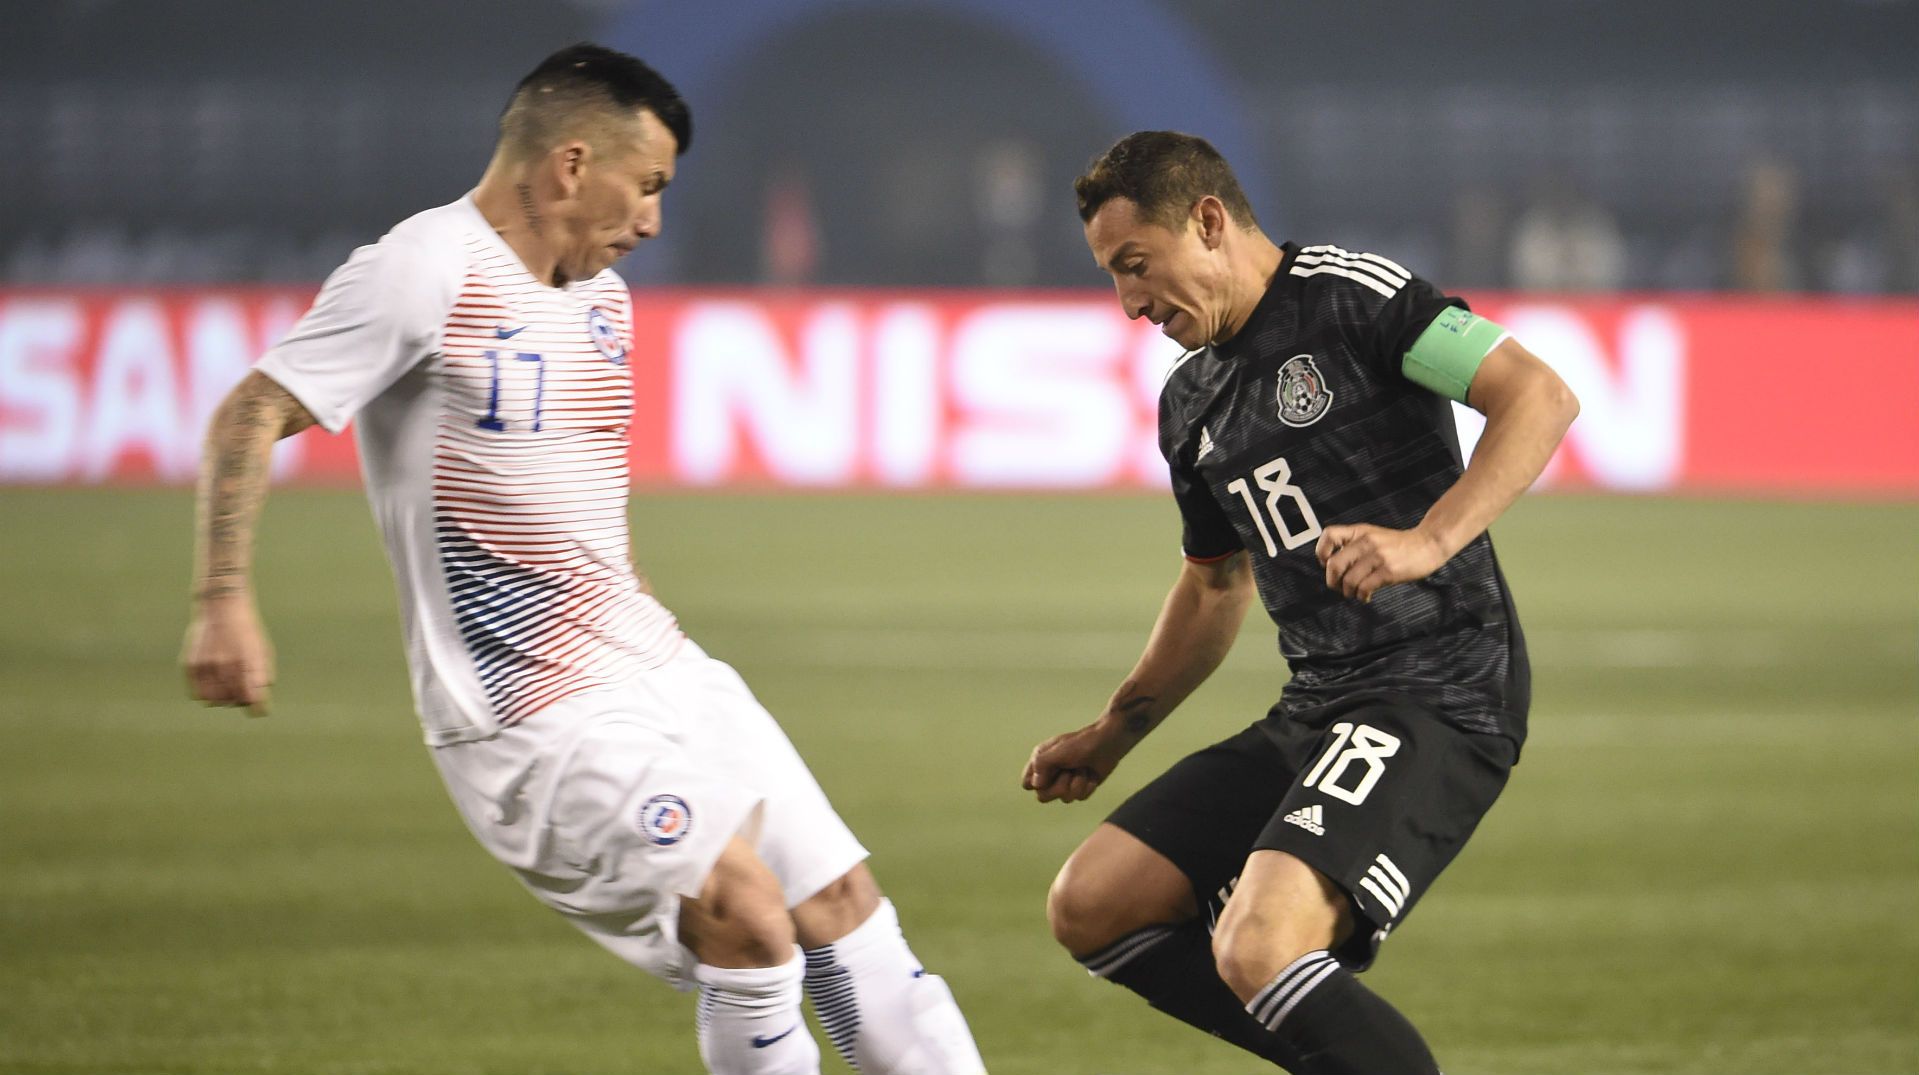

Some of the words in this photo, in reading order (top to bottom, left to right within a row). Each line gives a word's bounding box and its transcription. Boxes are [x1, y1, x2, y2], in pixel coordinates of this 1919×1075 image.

[475, 350, 543, 433] 17
[669, 302, 1688, 488] NISN
[1227, 457, 1322, 558] 18
[1303, 722, 1401, 806] 18
